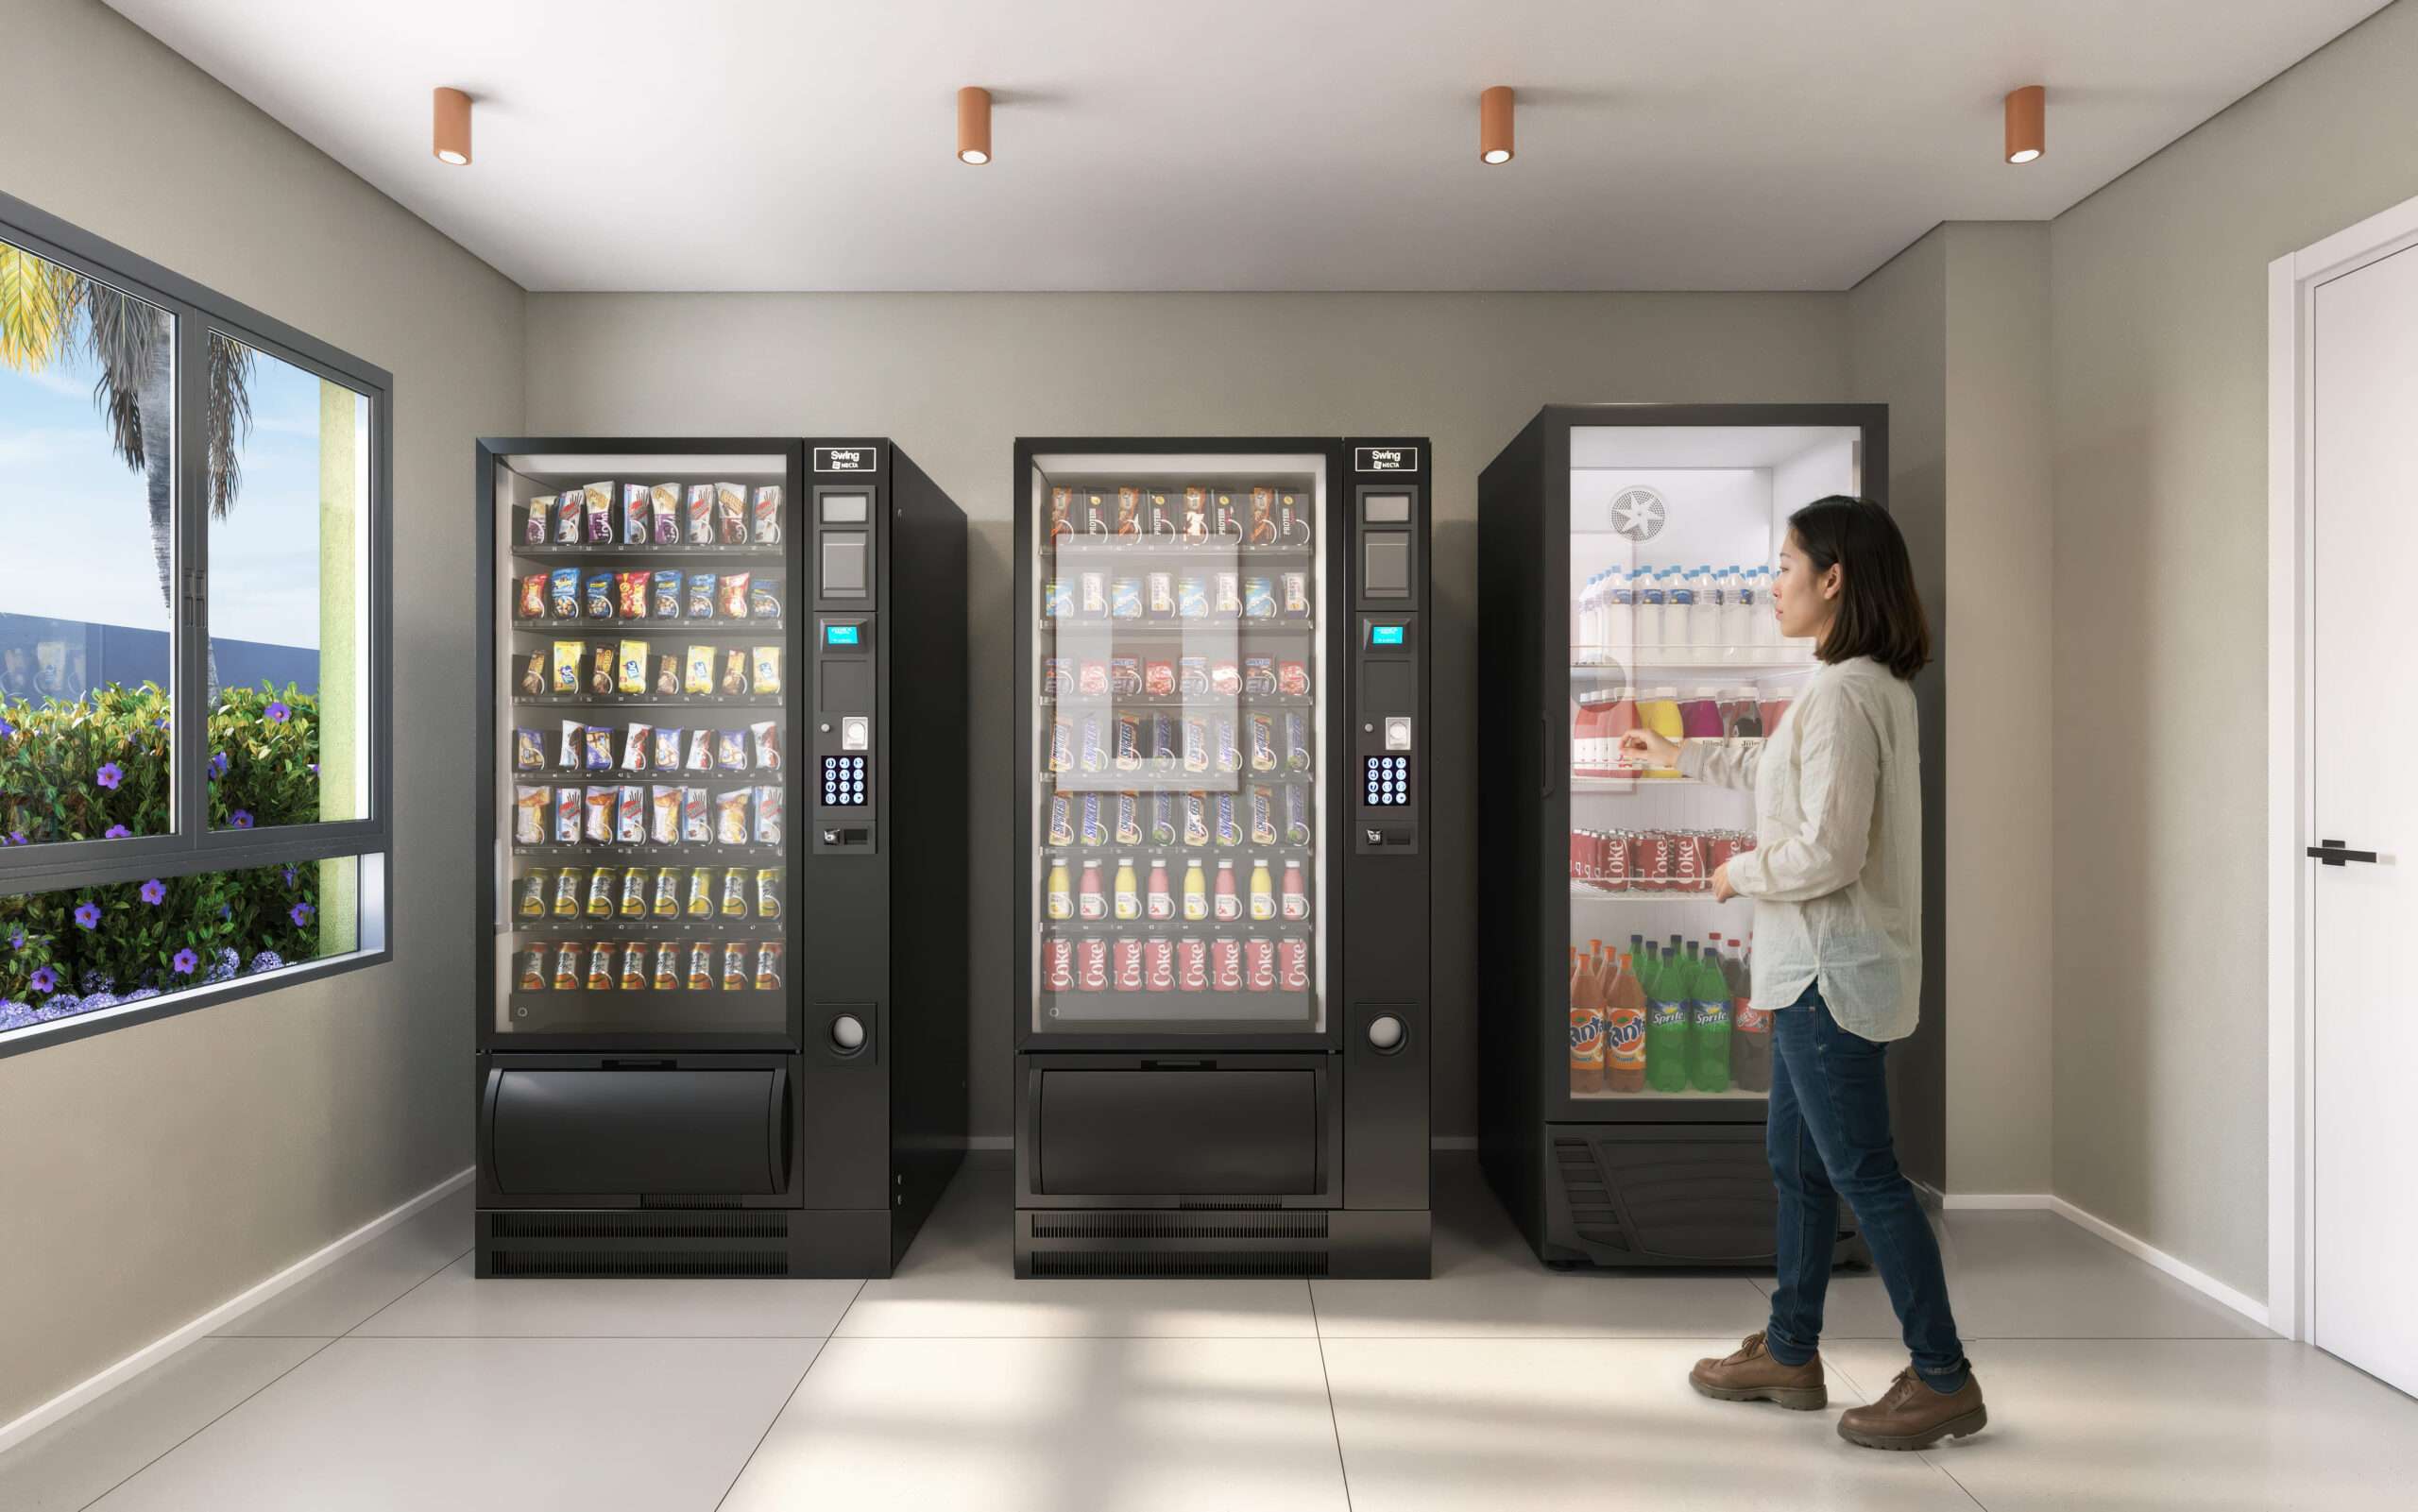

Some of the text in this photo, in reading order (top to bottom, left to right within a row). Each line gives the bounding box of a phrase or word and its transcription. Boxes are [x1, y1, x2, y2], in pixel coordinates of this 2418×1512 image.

[831, 450, 860, 462] Swing
[1372, 450, 1402, 462] Swing
[1188, 799, 1200, 833] SNERS
[1605, 841, 1625, 884] Coke
[1652, 841, 1669, 884] Coke
[1676, 841, 1695, 884] Coke
[1051, 943, 1069, 987] Coke
[1086, 943, 1104, 987] Coke
[1122, 943, 1140, 987] Coke
[1152, 943, 1171, 987] Coke
[1186, 943, 1204, 987] Coke
[1221, 943, 1239, 987] Coke
[1254, 943, 1272, 987] Coke
[1288, 943, 1306, 987] Coke
[1571, 1015, 1605, 1047] ant
[1653, 1011, 1684, 1025] Sprite
[1696, 1011, 1728, 1025] Sprite
